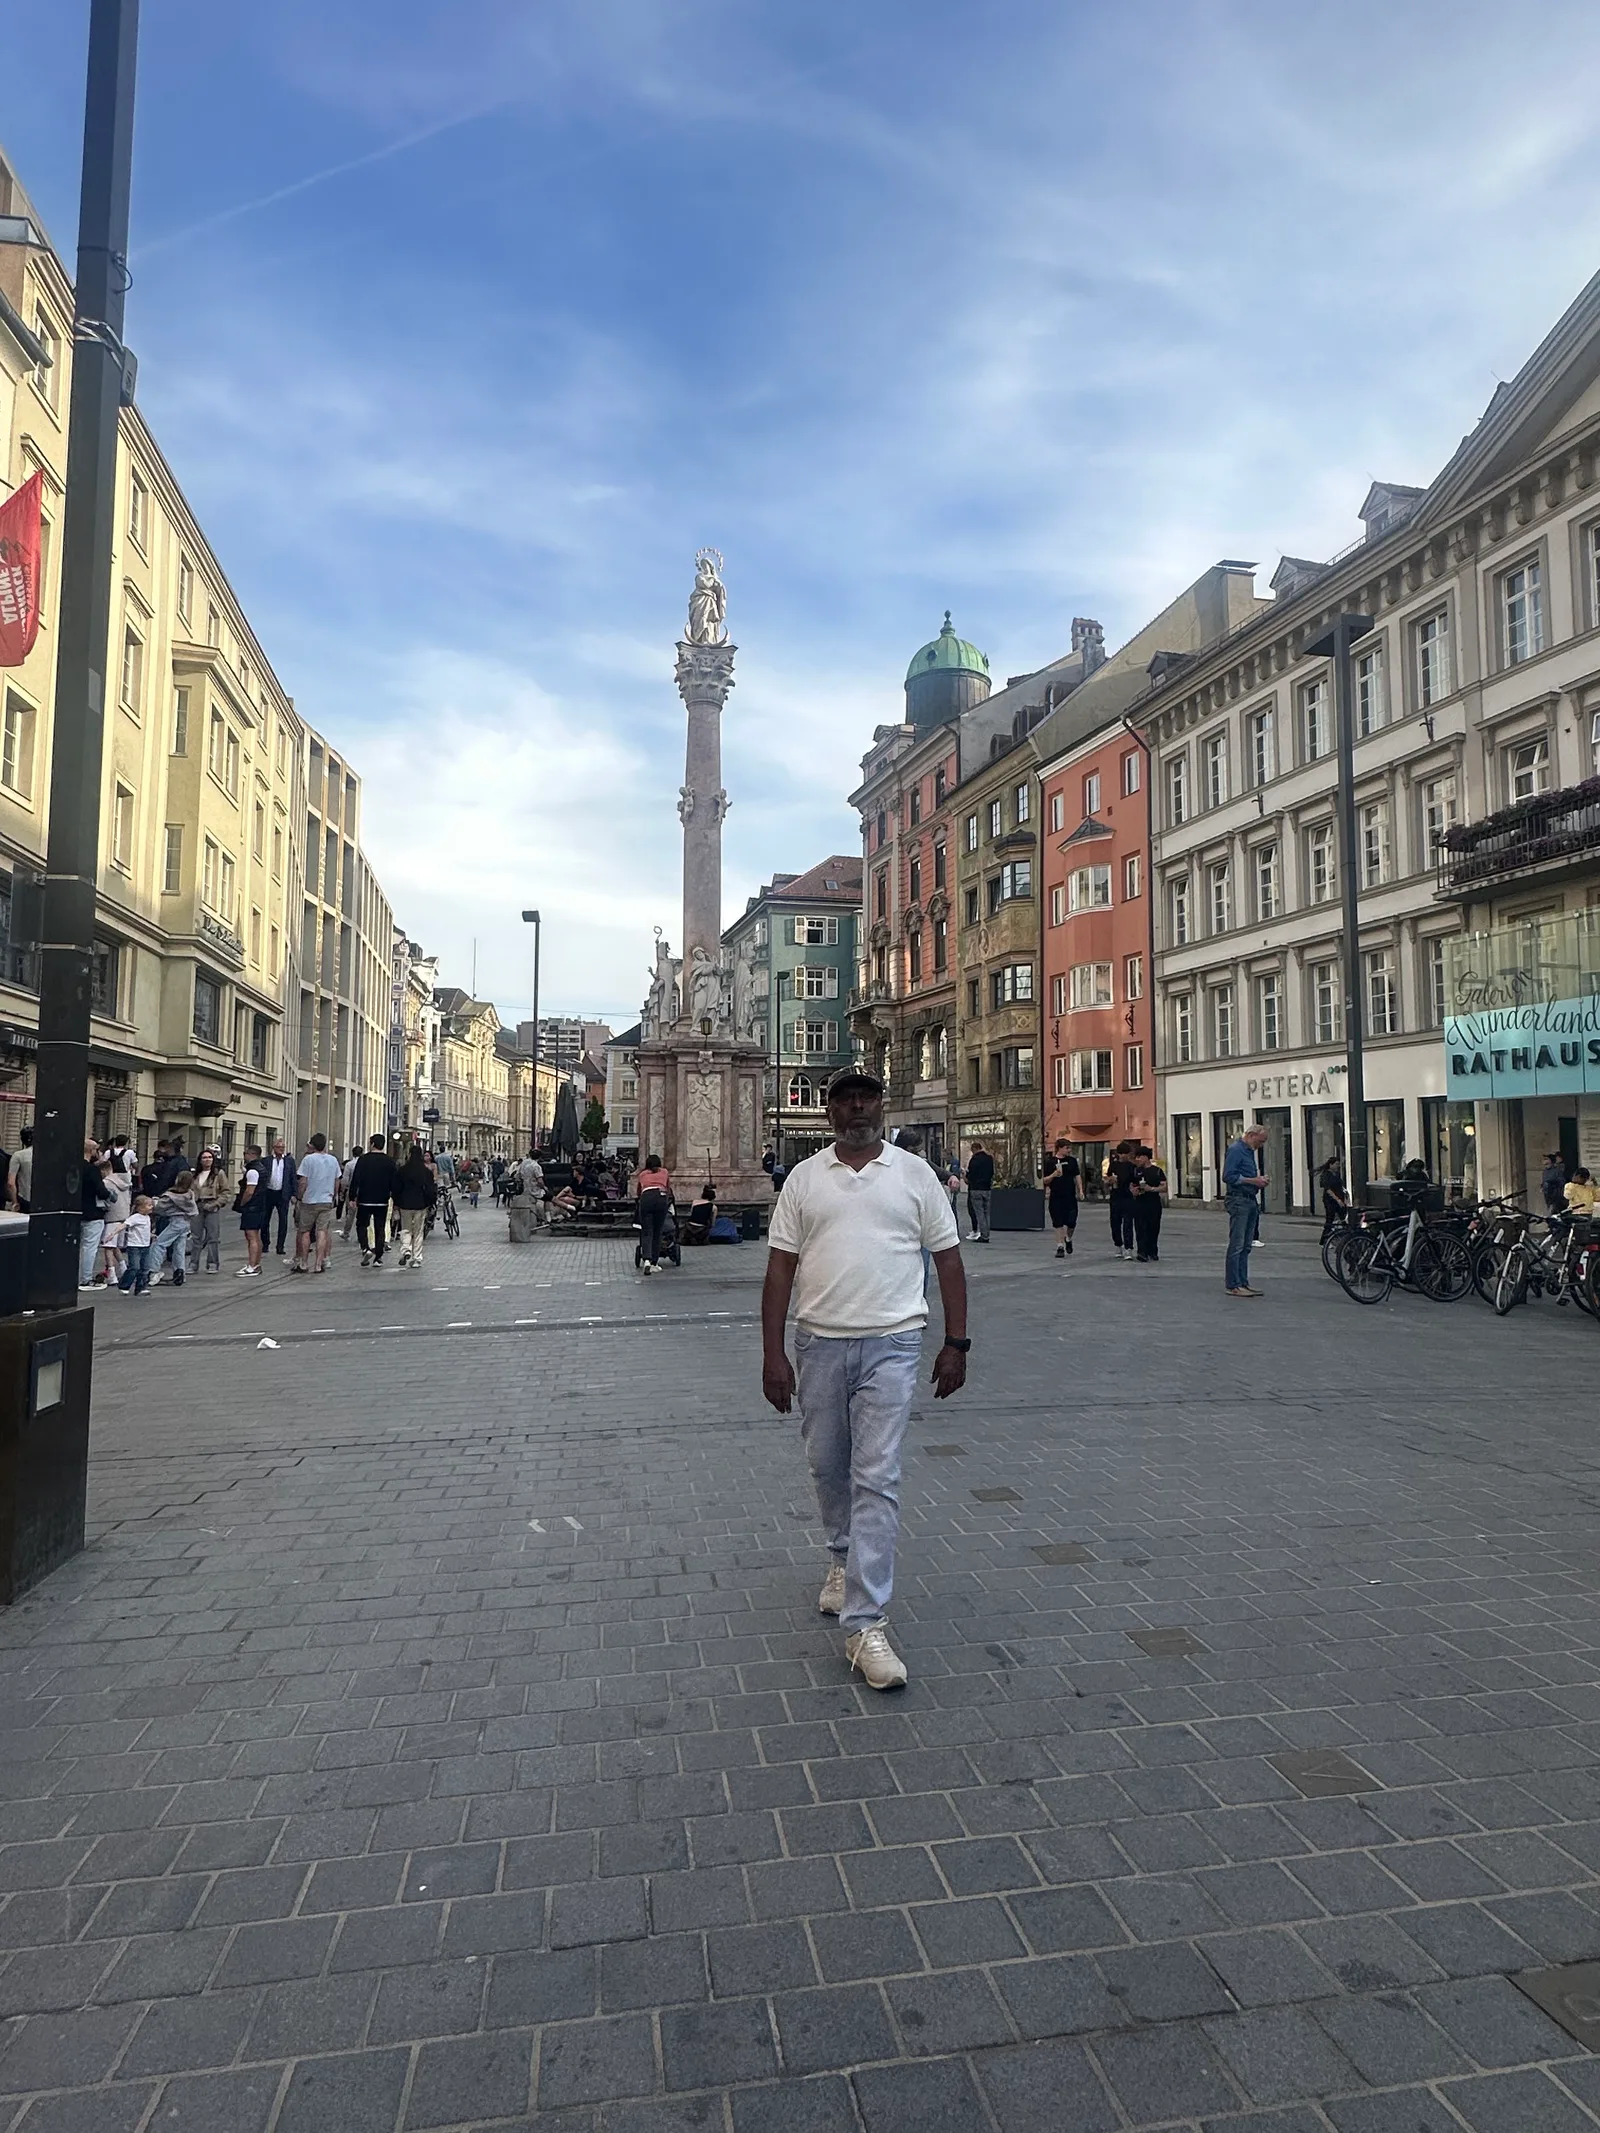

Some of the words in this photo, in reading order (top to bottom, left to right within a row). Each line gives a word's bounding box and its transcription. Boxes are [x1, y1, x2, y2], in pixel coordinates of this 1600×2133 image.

[331, 945, 341, 1051] KAUFHAUS
[1456, 970, 1533, 1006] Galerien
[1447, 990, 1600, 1050] Wunderland
[1452, 1038, 1600, 1075] RATHAUS
[1247, 1071, 1331, 1101] PETERA
